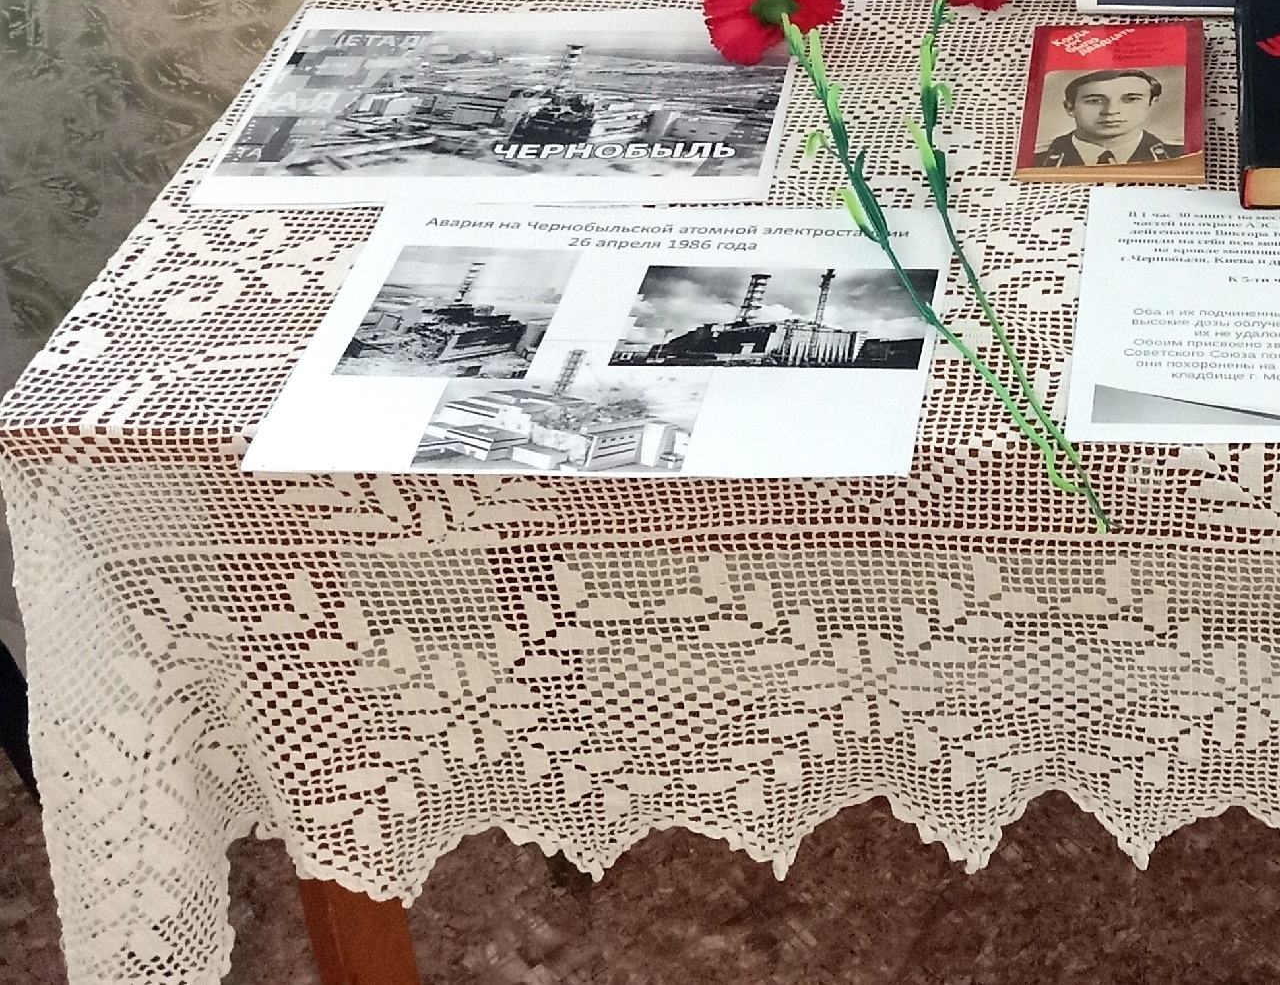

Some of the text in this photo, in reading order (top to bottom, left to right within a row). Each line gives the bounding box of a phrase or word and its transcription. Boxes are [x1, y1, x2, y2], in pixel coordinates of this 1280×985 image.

[493, 142, 736, 159] ЧЕРНОБЫЛЬ
[426, 217, 910, 238] Авария на Чернобыльской атомной электростаии
[568, 237, 757, 251] 26 апреля 1986 года
[1133, 308, 1162, 316] Оба
[1194, 319, 1229, 328] дозы
[1133, 338, 1183, 347] Обоим
[1187, 341, 1262, 349] присвоено
[1124, 349, 1205, 357] Советского
[1210, 350, 1256, 359] Союза
[1166, 361, 1254, 370] похоронены
[1171, 372, 1244, 381] кладбище
